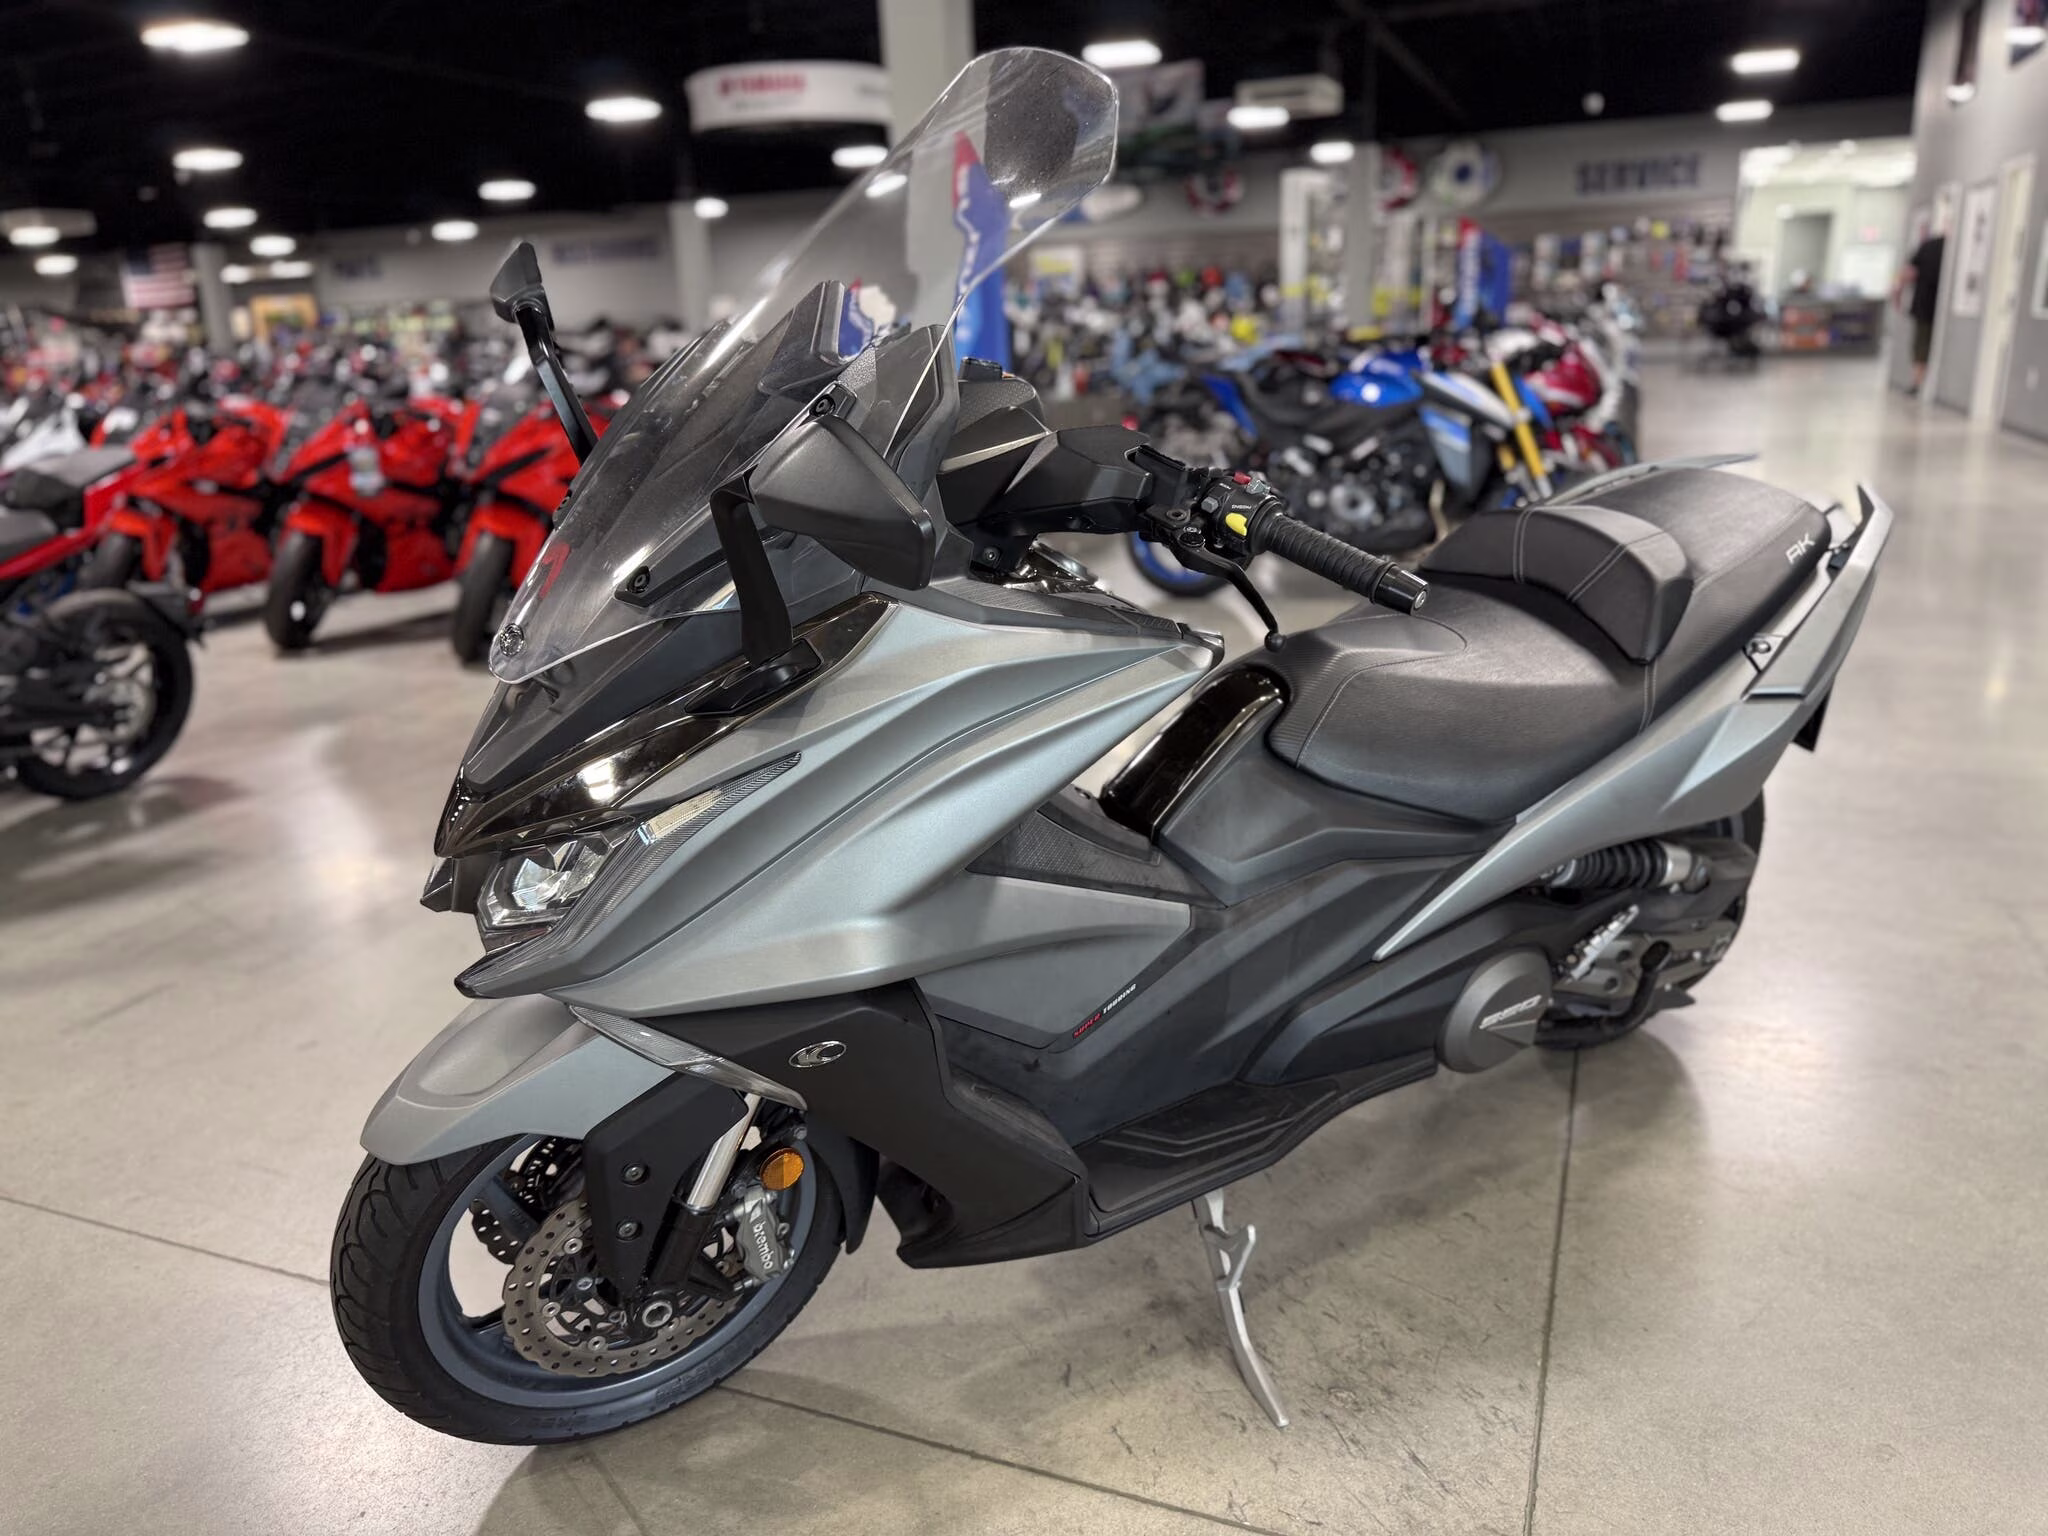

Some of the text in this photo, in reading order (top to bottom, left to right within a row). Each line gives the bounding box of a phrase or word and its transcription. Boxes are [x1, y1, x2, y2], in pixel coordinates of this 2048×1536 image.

[1576, 154, 1701, 194] SERVICE
[1785, 533, 1815, 564] AK
[1103, 983, 1136, 1014] TOURING
[752, 1221, 773, 1269] brembo
